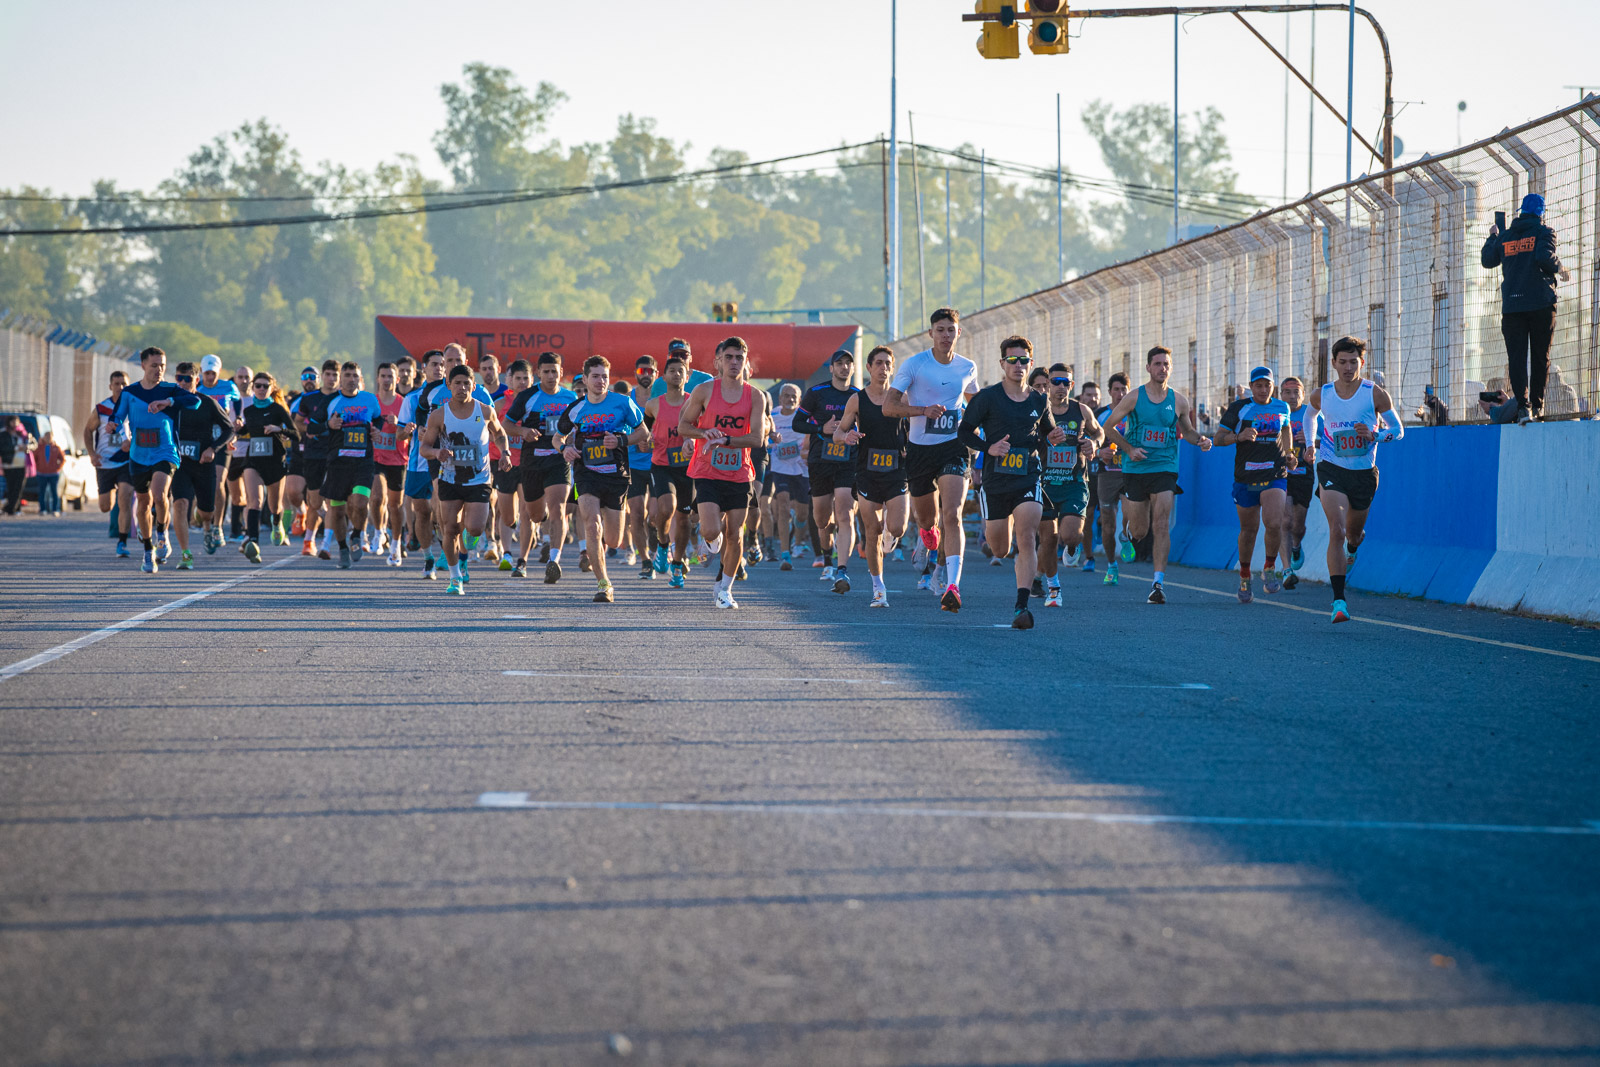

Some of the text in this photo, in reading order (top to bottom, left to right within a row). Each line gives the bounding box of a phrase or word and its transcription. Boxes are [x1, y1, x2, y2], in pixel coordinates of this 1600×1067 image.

[714, 415, 745, 429] KRC
[934, 415, 953, 429] 106
[1146, 430, 1165, 442] 344
[255, 441, 265, 452] 21
[827, 443, 845, 456] 782
[1341, 436, 1363, 450] 303
[180, 445, 196, 456] 167
[455, 449, 474, 461] 174
[587, 445, 607, 459] 707
[717, 452, 737, 465] 313
[873, 454, 893, 467] 718
[1053, 452, 1071, 463] 317
